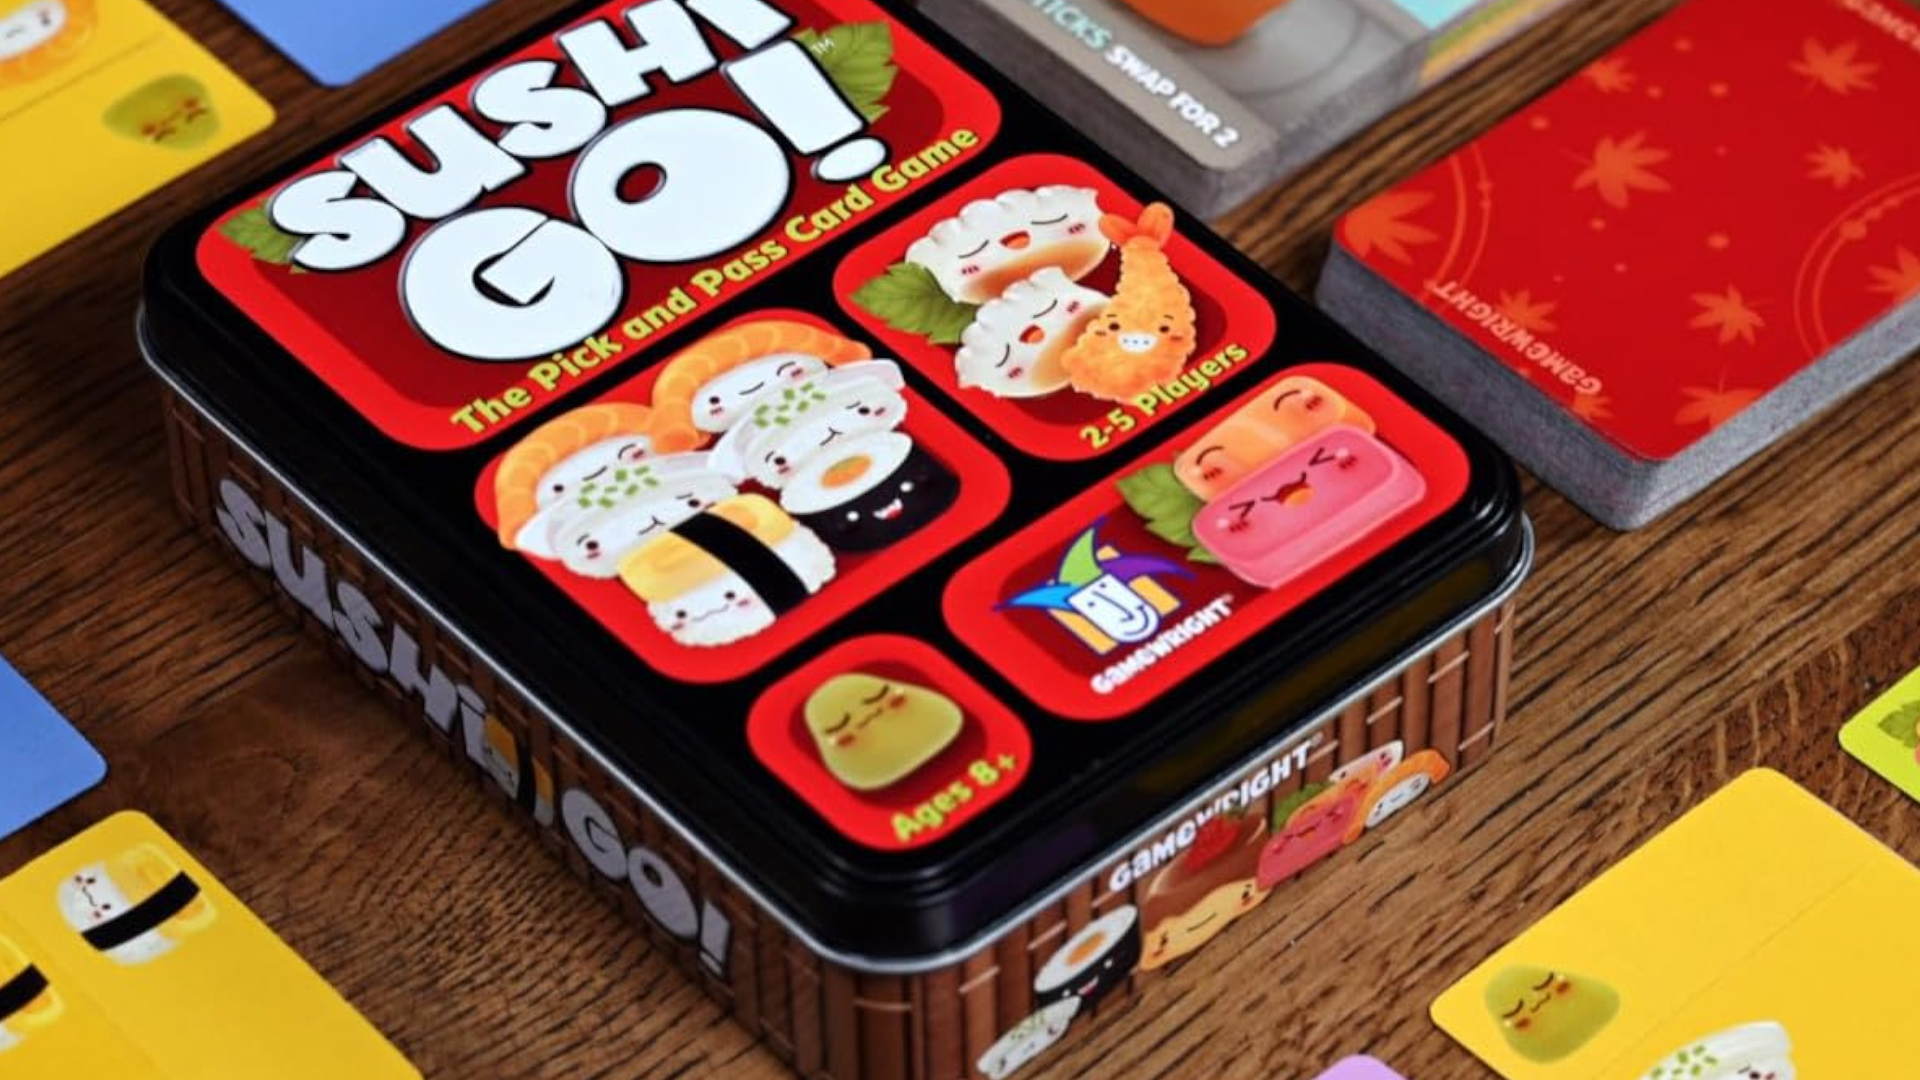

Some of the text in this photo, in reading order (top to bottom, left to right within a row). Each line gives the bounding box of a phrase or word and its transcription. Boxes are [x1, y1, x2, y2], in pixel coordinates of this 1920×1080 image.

[1103, 44, 1177, 97] SWAP
[1168, 91, 1221, 135] FOR
[1212, 125, 1240, 149] 2
[400, 37, 888, 362] GO!
[450, 128, 980, 434] The Pick and Pass Card Game
[1079, 341, 1249, 450] 2-5 Players
[890, 755, 1016, 844] Ages 8+
[560, 788, 732, 978] GO!
